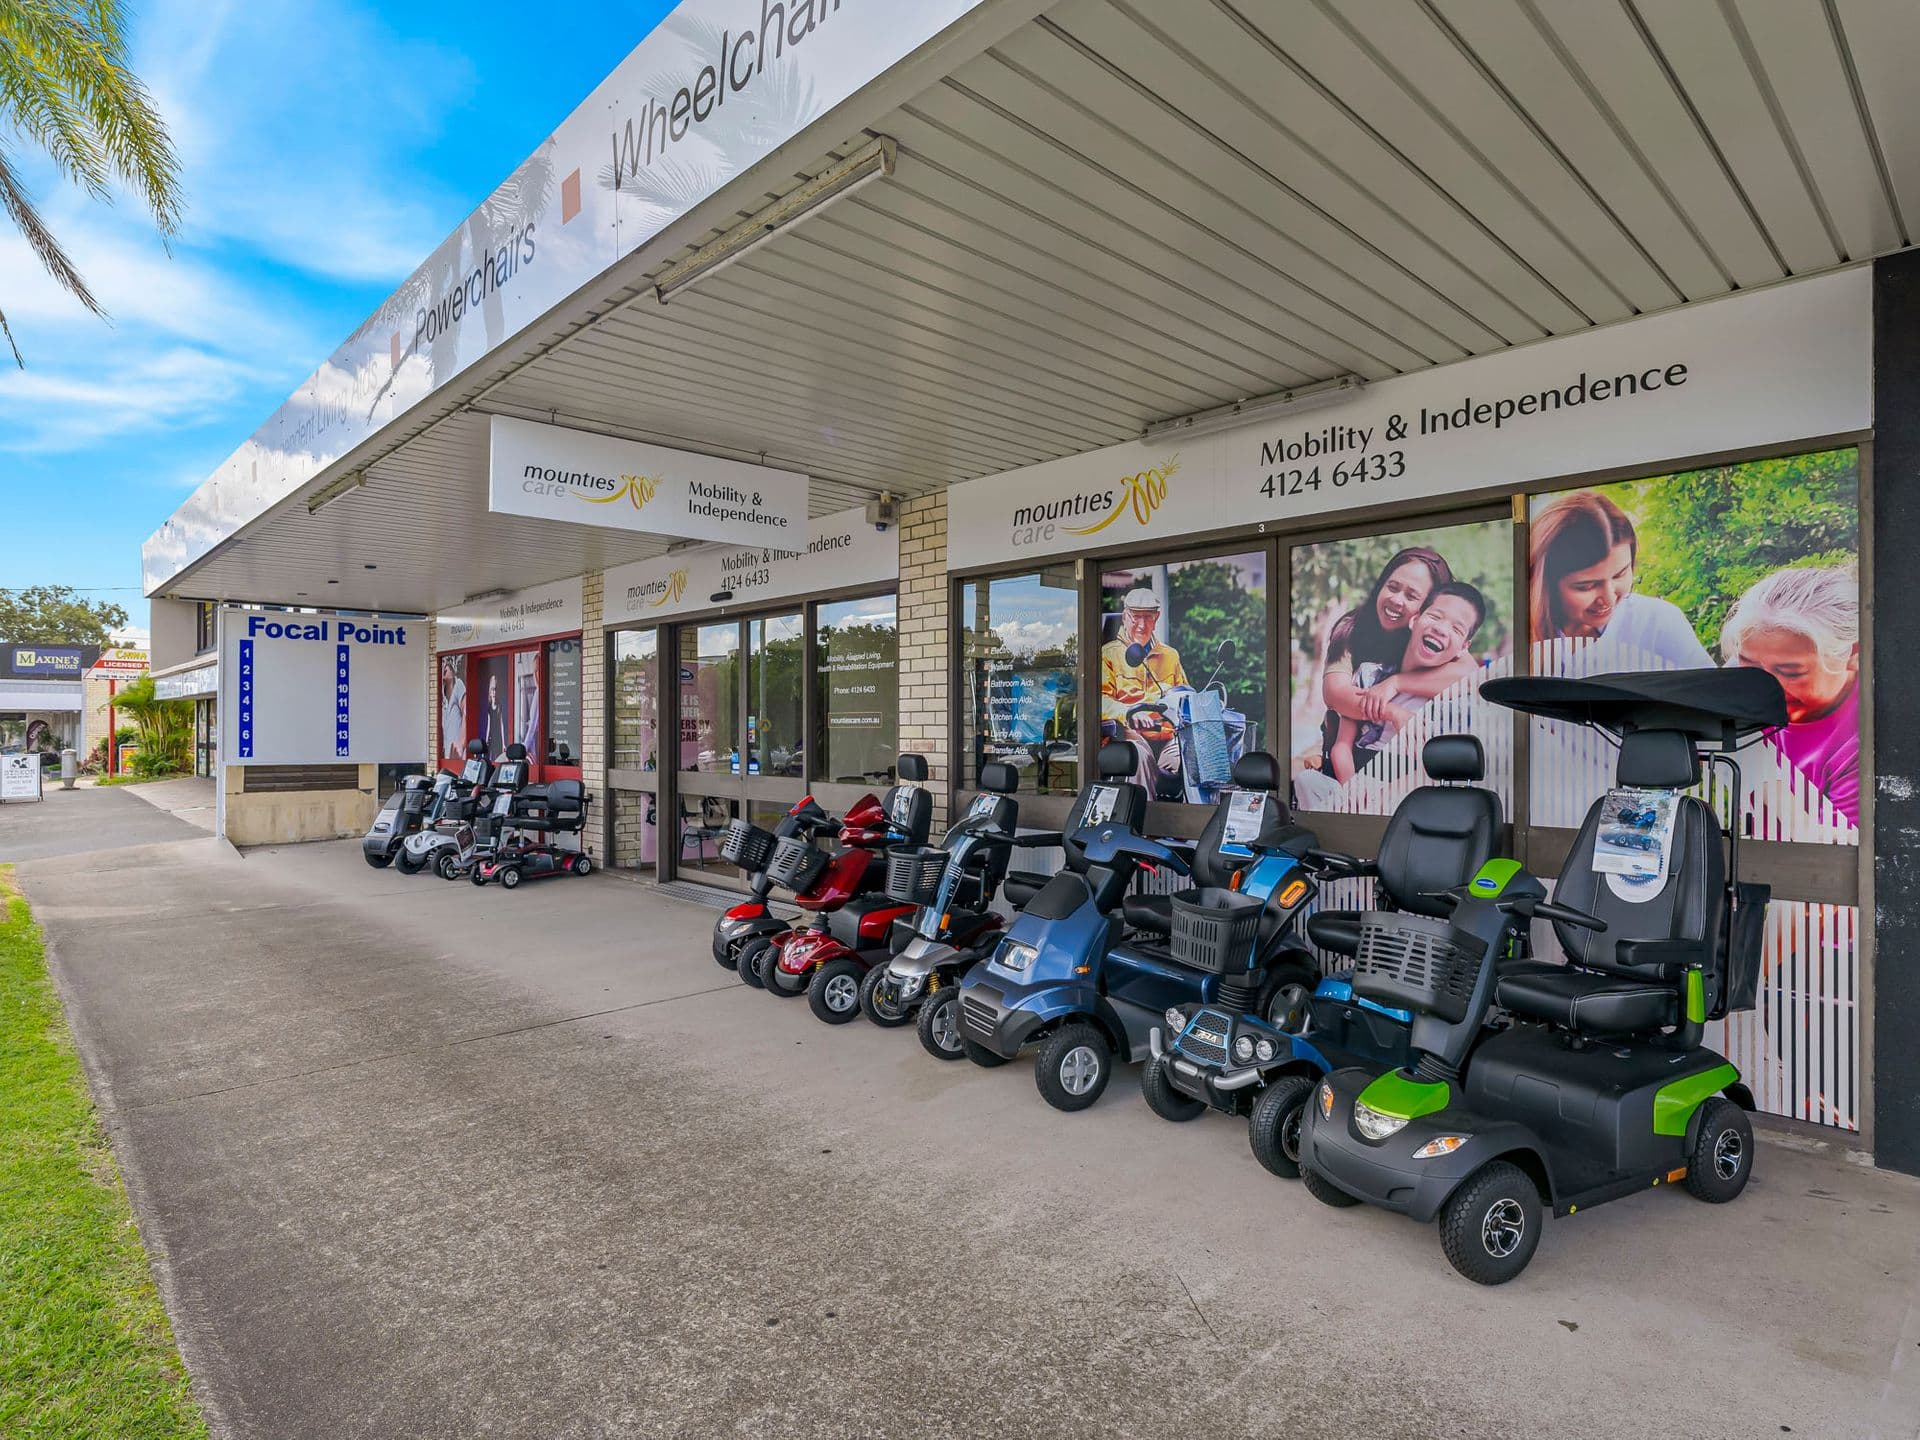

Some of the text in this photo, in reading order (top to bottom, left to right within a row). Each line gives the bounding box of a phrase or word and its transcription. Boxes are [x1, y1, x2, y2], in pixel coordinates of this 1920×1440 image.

[612, 0, 840, 192] Wheelcha
[415, 222, 536, 354] Powerchairs
[1260, 363, 1689, 467] Mobility & Independence
[523, 464, 616, 491] mounties
[1260, 451, 1407, 499] 4124 6433
[522, 479, 566, 498] care
[688, 480, 763, 506] Mobility &
[688, 499, 789, 528] Independence
[1013, 490, 1113, 527] mounties
[1258, 523, 1265, 532] 3
[1012, 523, 1055, 547] care
[721, 552, 760, 573] Mobility
[762, 548, 771, 564] &
[720, 569, 770, 592] 4124 6433
[627, 579, 667, 600] mounties
[525, 598, 563, 615] Independence
[248, 616, 406, 645] Focal Point
[243, 649, 250, 658] 1
[339, 653, 347, 662] 8
[19, 653, 80, 666] MAXINE'S
[243, 665, 250, 674] 2
[990, 661, 1014, 672] Walkers
[339, 669, 347, 678] 9
[243, 682, 250, 691] 3
[990, 678, 1034, 688] Bathroom Aids
[337, 684, 348, 693] 10
[863, 685, 876, 693] 6433
[242, 696, 250, 705] 4
[338, 699, 348, 707] 11
[990, 695, 1033, 705] Bedroom Aids
[242, 713, 250, 722] 5
[337, 714, 348, 722] 12
[990, 712, 1027, 721] Kitchen Aids
[242, 730, 250, 739] 6
[337, 730, 348, 739] 13
[990, 728, 1022, 740] Living Aids
[242, 748, 250, 756] 7
[337, 747, 348, 755] 14
[990, 746, 1028, 755] Transfer Aids
